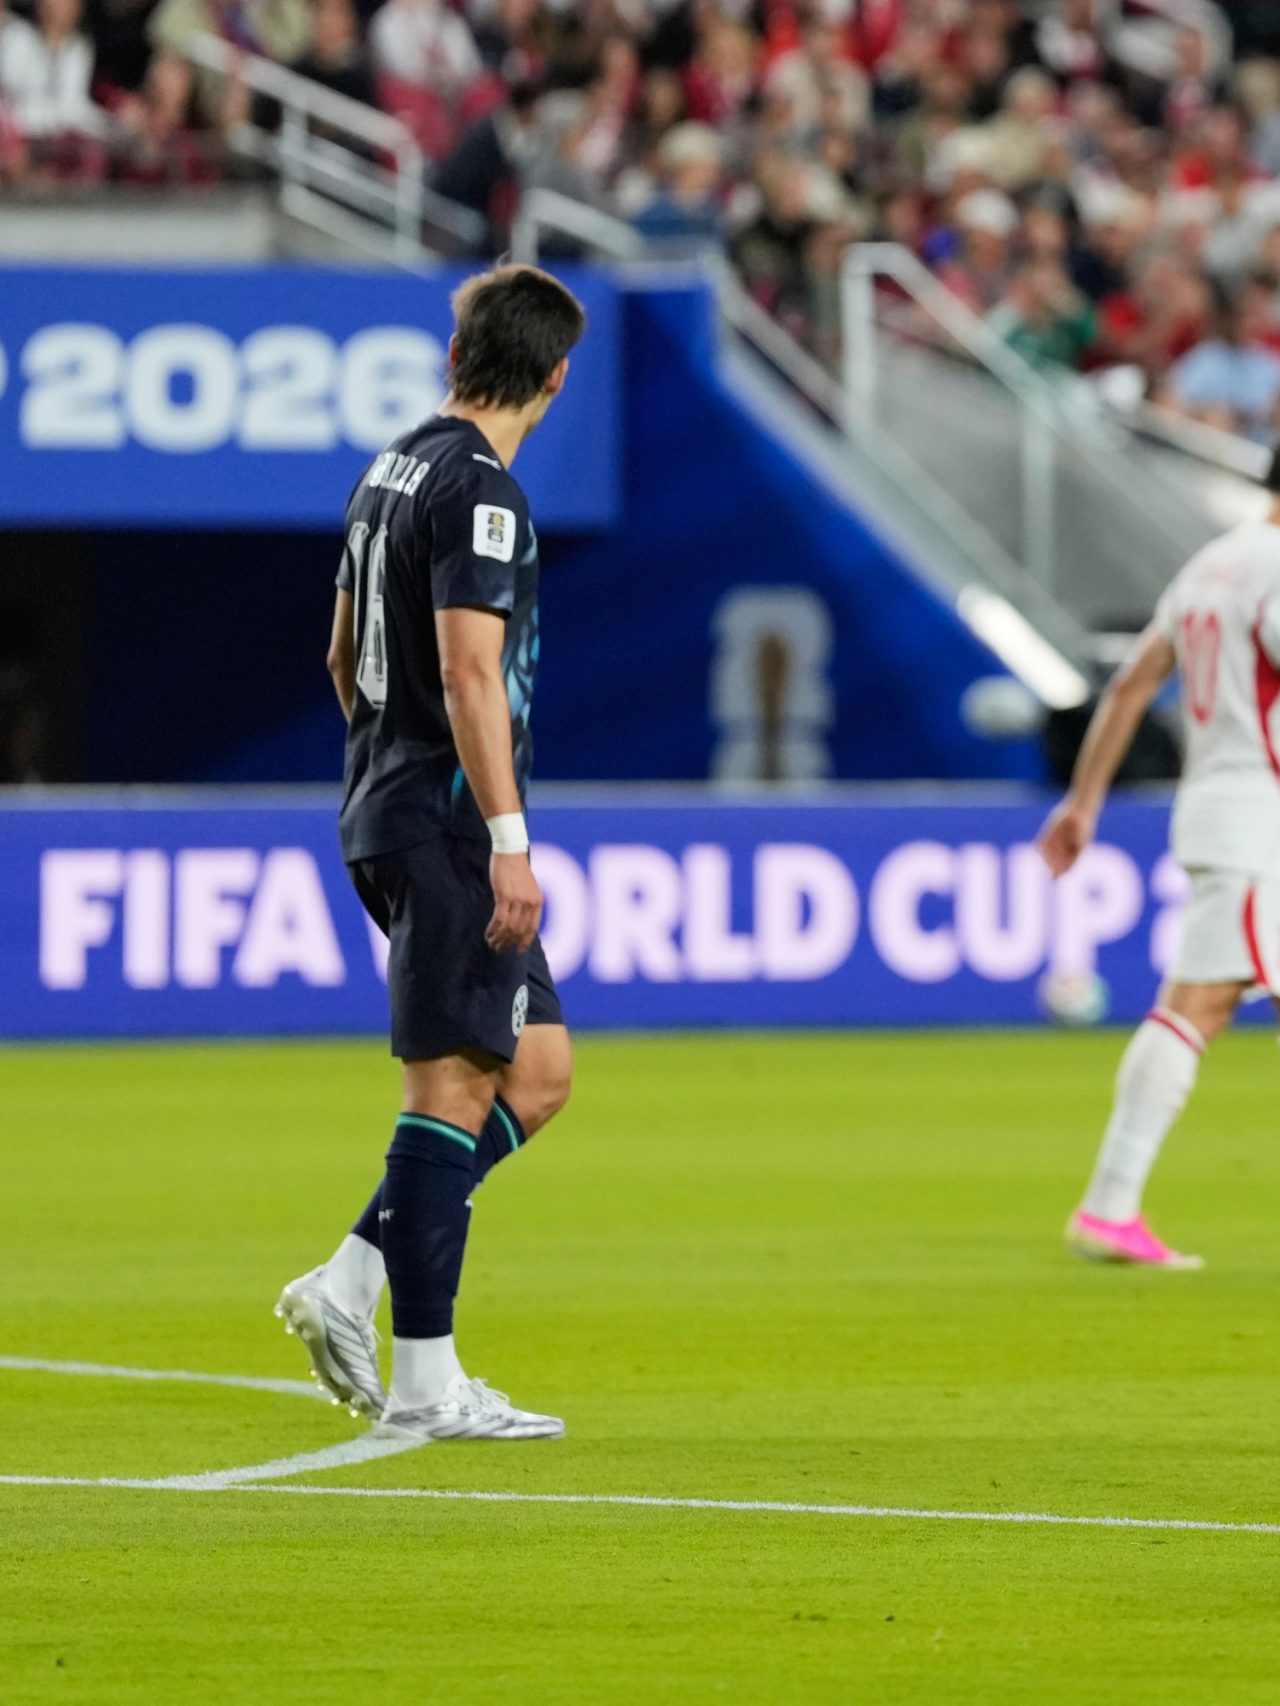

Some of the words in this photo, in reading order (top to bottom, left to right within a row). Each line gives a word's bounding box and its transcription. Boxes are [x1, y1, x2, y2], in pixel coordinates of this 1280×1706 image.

[20, 322, 450, 453] 2026
[1177, 608, 1223, 728] 10
[40, 846, 347, 990] FIFA
[868, 840, 1143, 984] CUP
